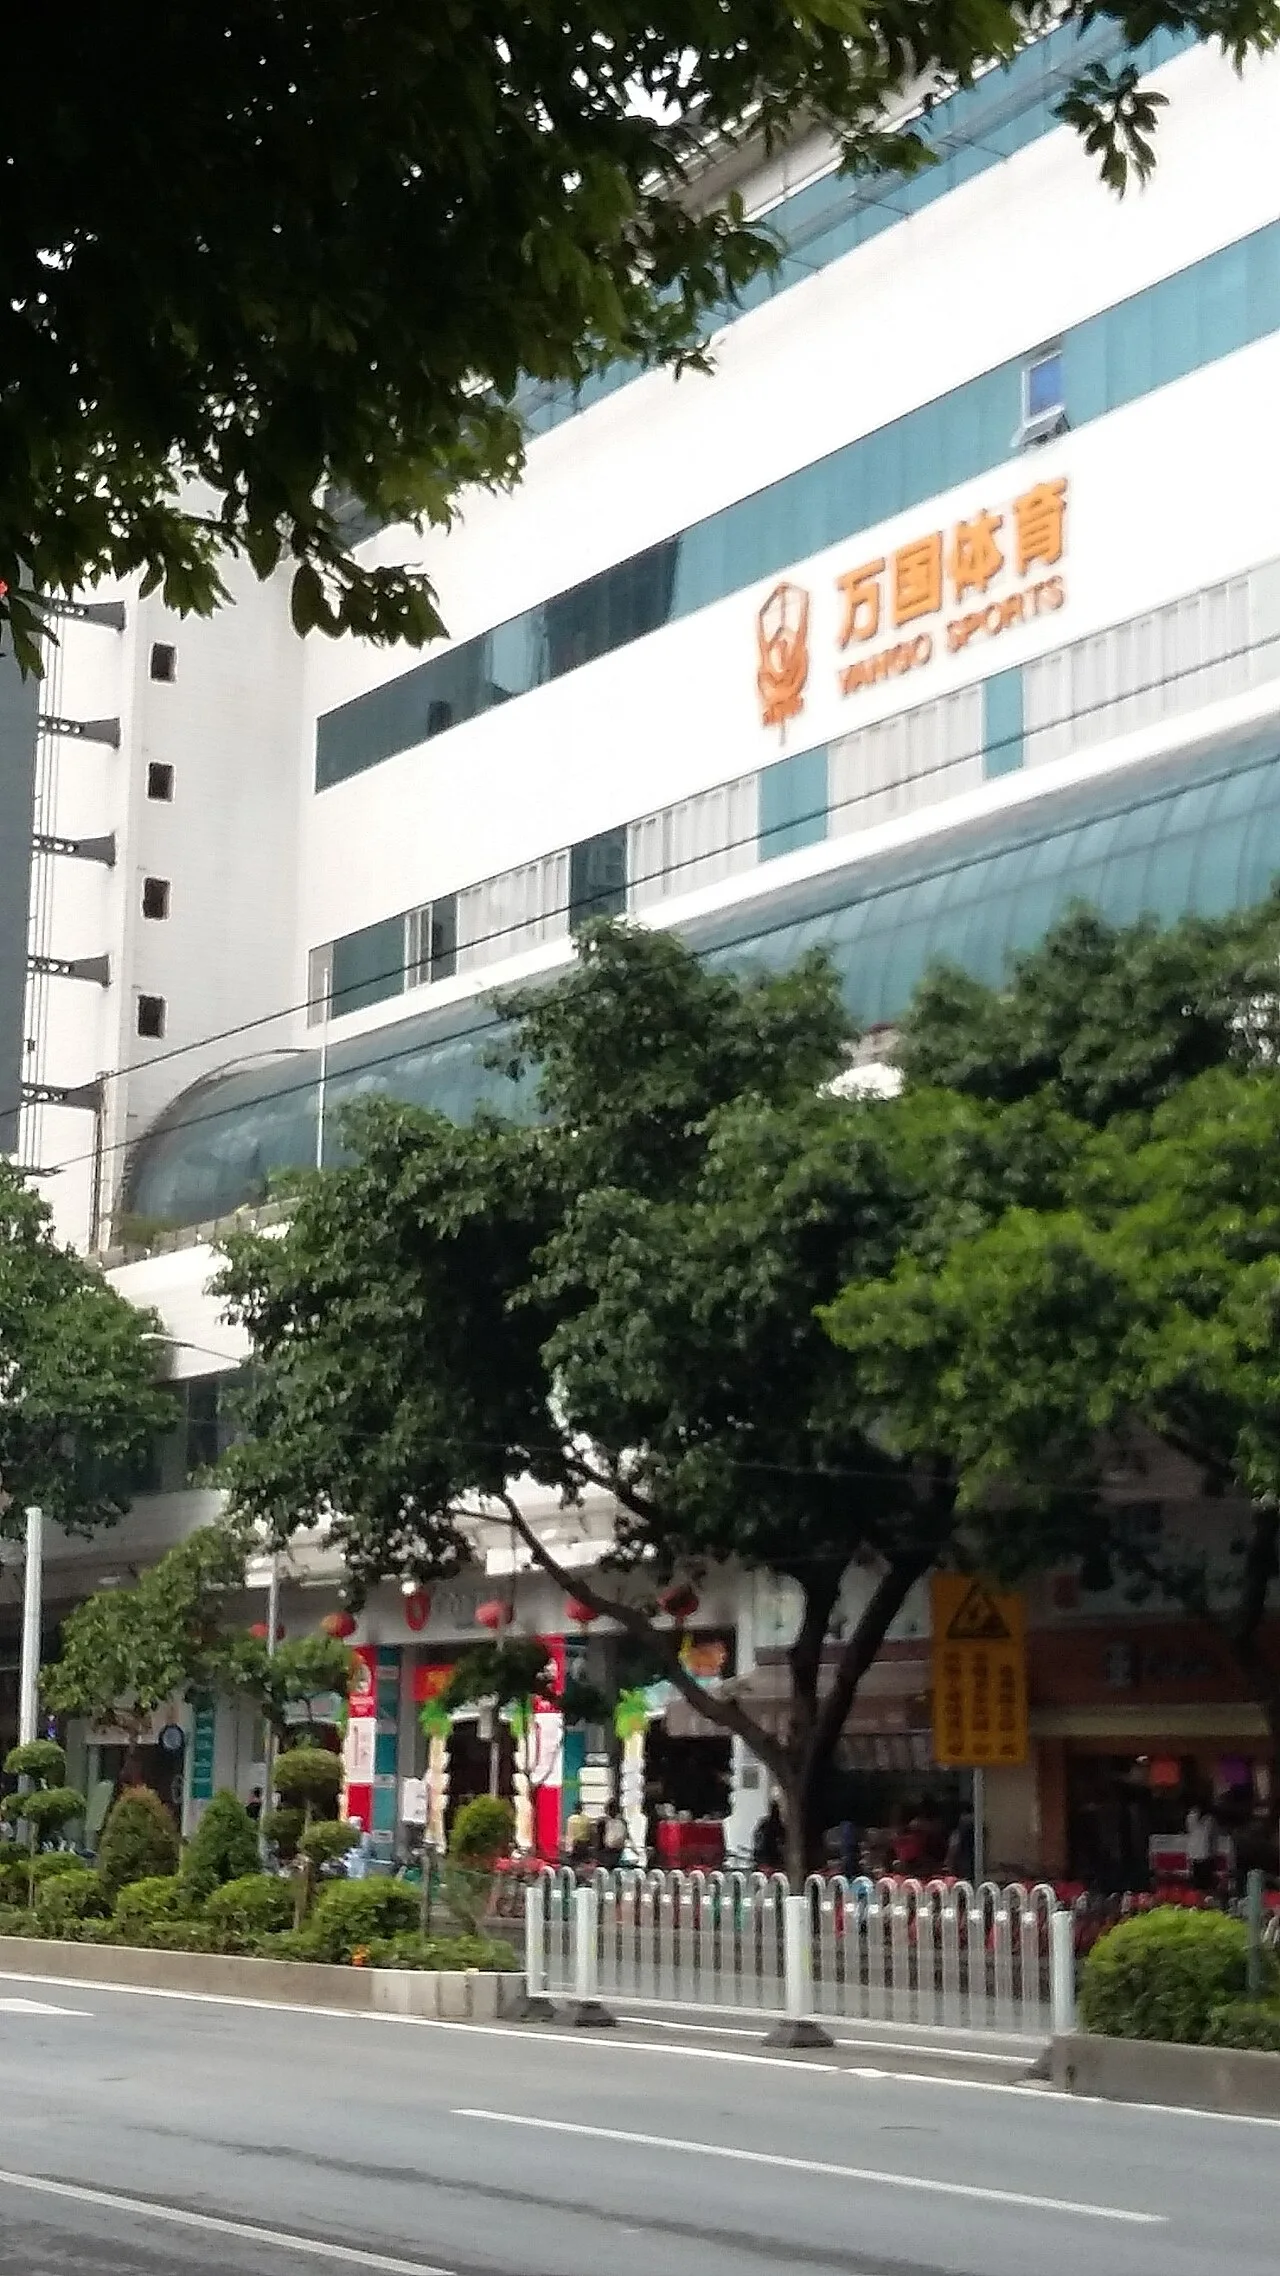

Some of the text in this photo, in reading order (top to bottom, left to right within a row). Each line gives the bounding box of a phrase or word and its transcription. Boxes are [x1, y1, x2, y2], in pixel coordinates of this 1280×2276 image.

[836, 477, 1068, 650] 万国体育
[946, 575, 1065, 653] SPORTS
